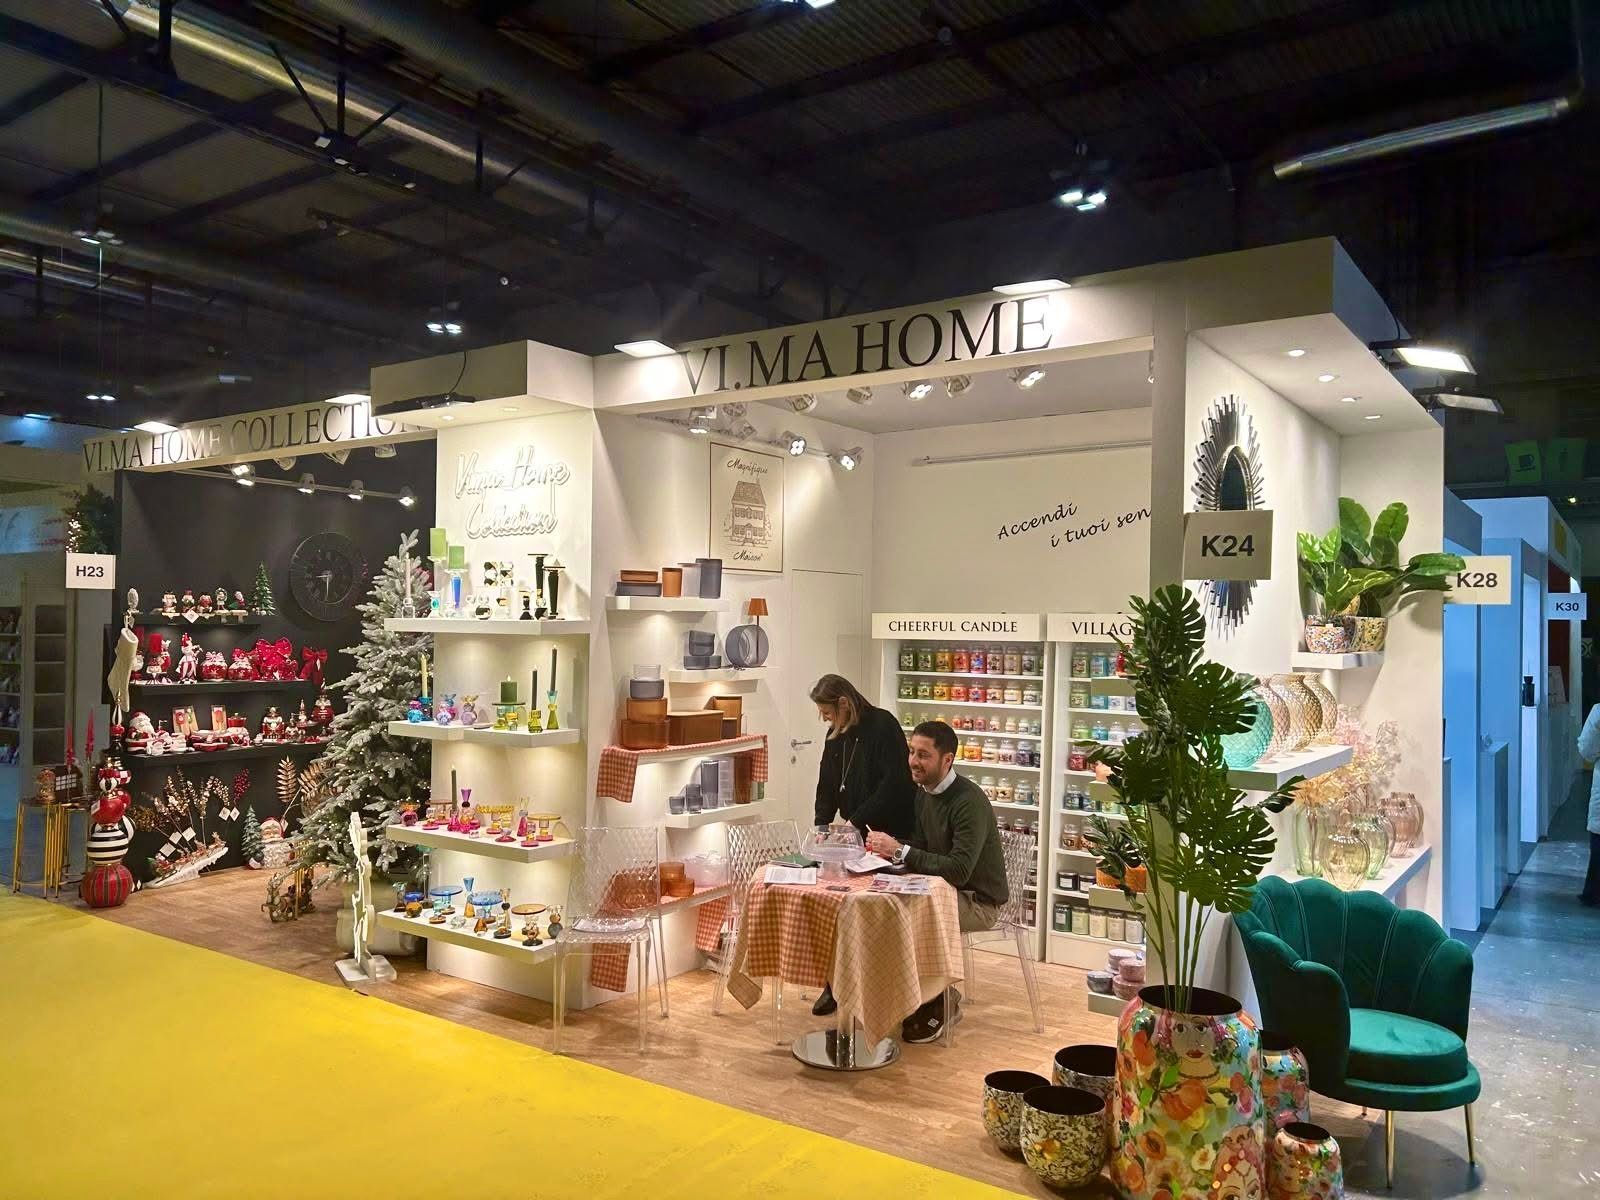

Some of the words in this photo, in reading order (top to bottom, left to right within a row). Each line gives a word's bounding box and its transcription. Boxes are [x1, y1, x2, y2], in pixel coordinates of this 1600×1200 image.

[680, 330, 837, 395] VI.MA
[851, 295, 1053, 375] HOME
[83, 437, 144, 472] VI.MA
[151, 423, 222, 464] HOME
[231, 400, 422, 455] COLLECTI
[510, 444, 570, 487] Home
[998, 502, 1077, 540] Accendi
[1050, 534, 1060, 548] i
[1064, 518, 1110, 543] tuoi
[1201, 534, 1255, 557] K24
[76, 565, 104, 578] H23
[1456, 572, 1498, 588] K28
[1555, 602, 1580, 612] K30
[888, 620, 956, 632] CHEERFUL
[960, 621, 1018, 633] CANDLE
